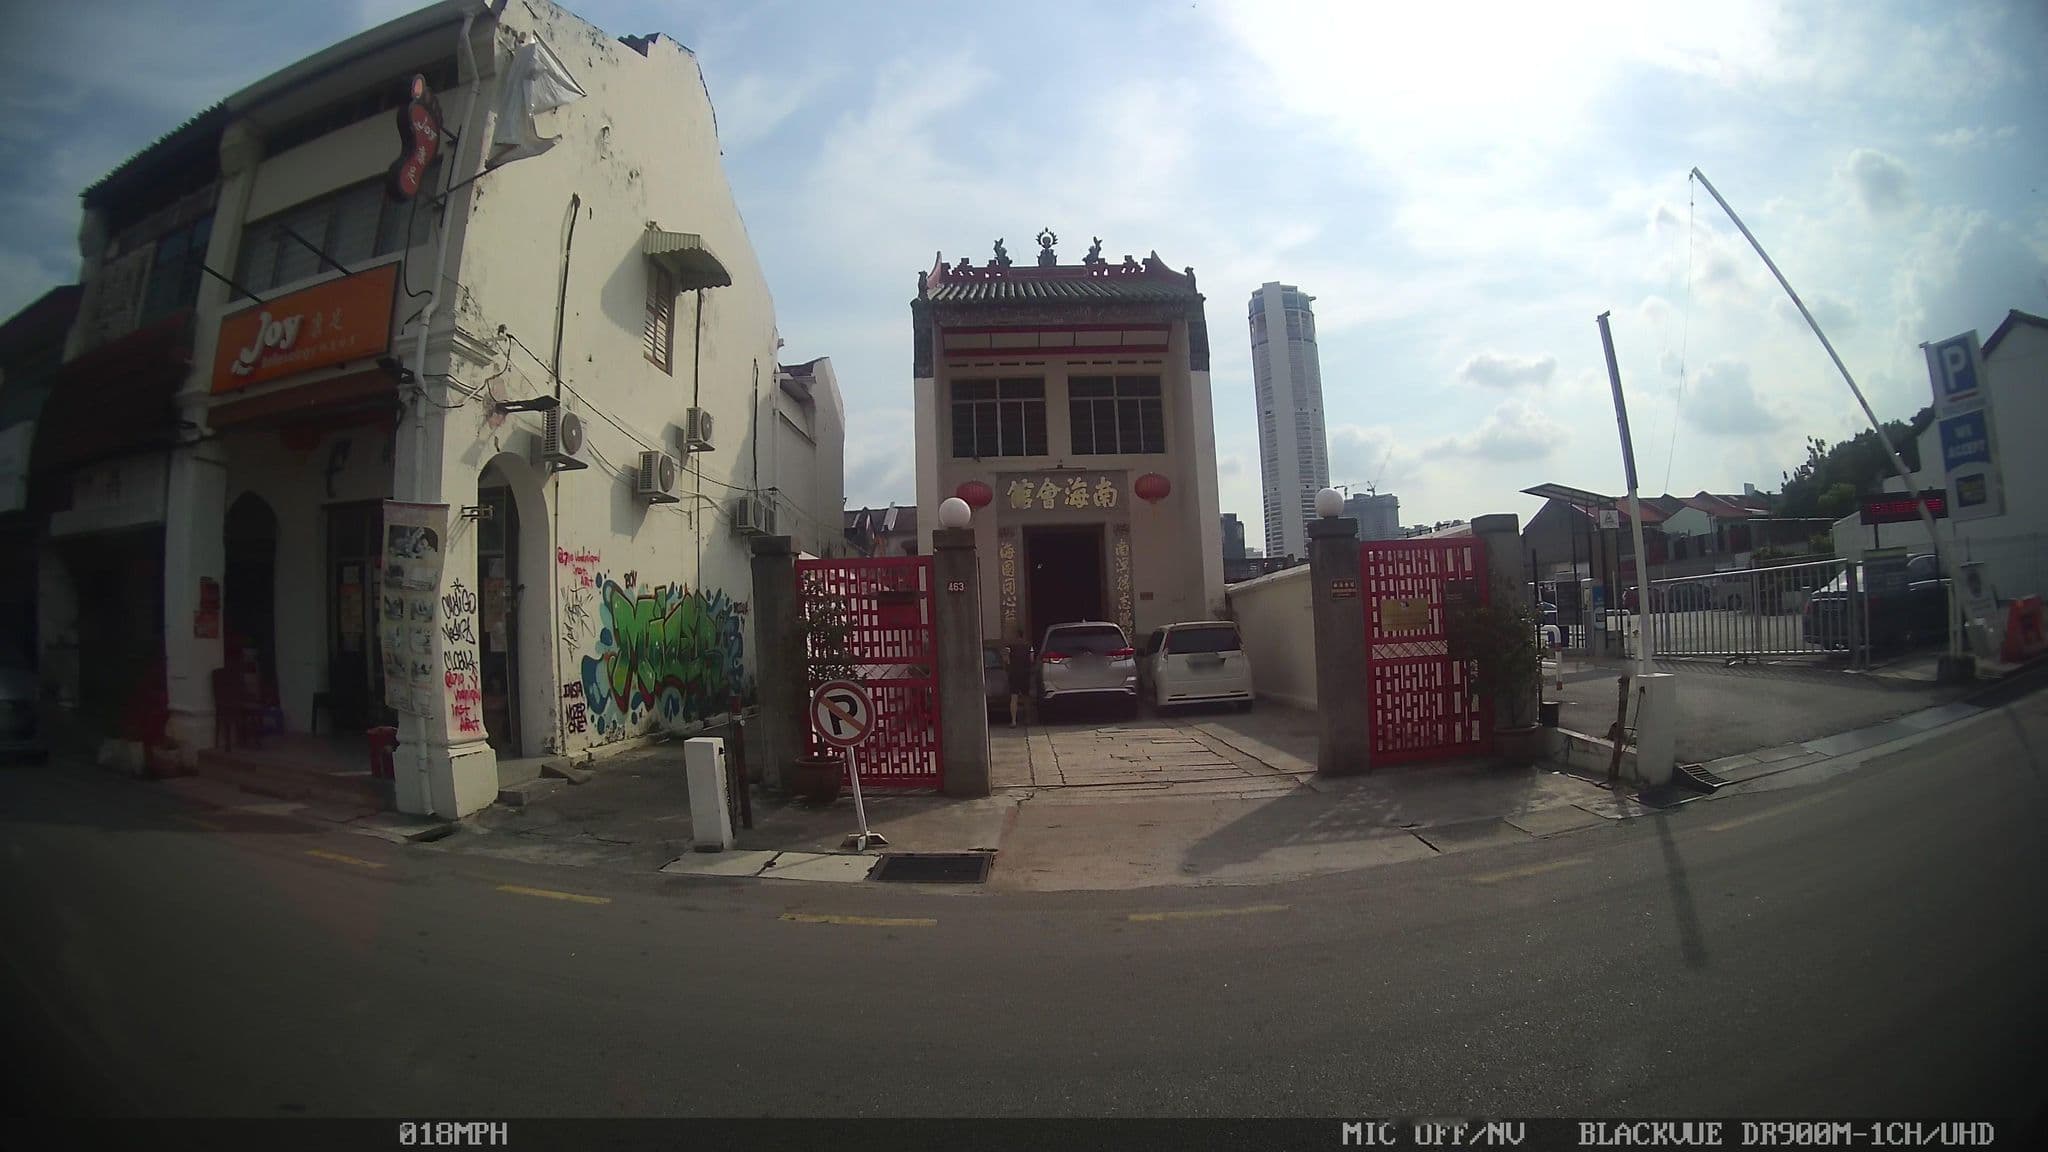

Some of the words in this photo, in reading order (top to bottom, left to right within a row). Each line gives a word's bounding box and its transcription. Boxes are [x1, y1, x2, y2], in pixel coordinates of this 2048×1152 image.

[231, 311, 304, 376] Joy
[1942, 345, 1966, 391] P
[948, 582, 965, 592] 463
